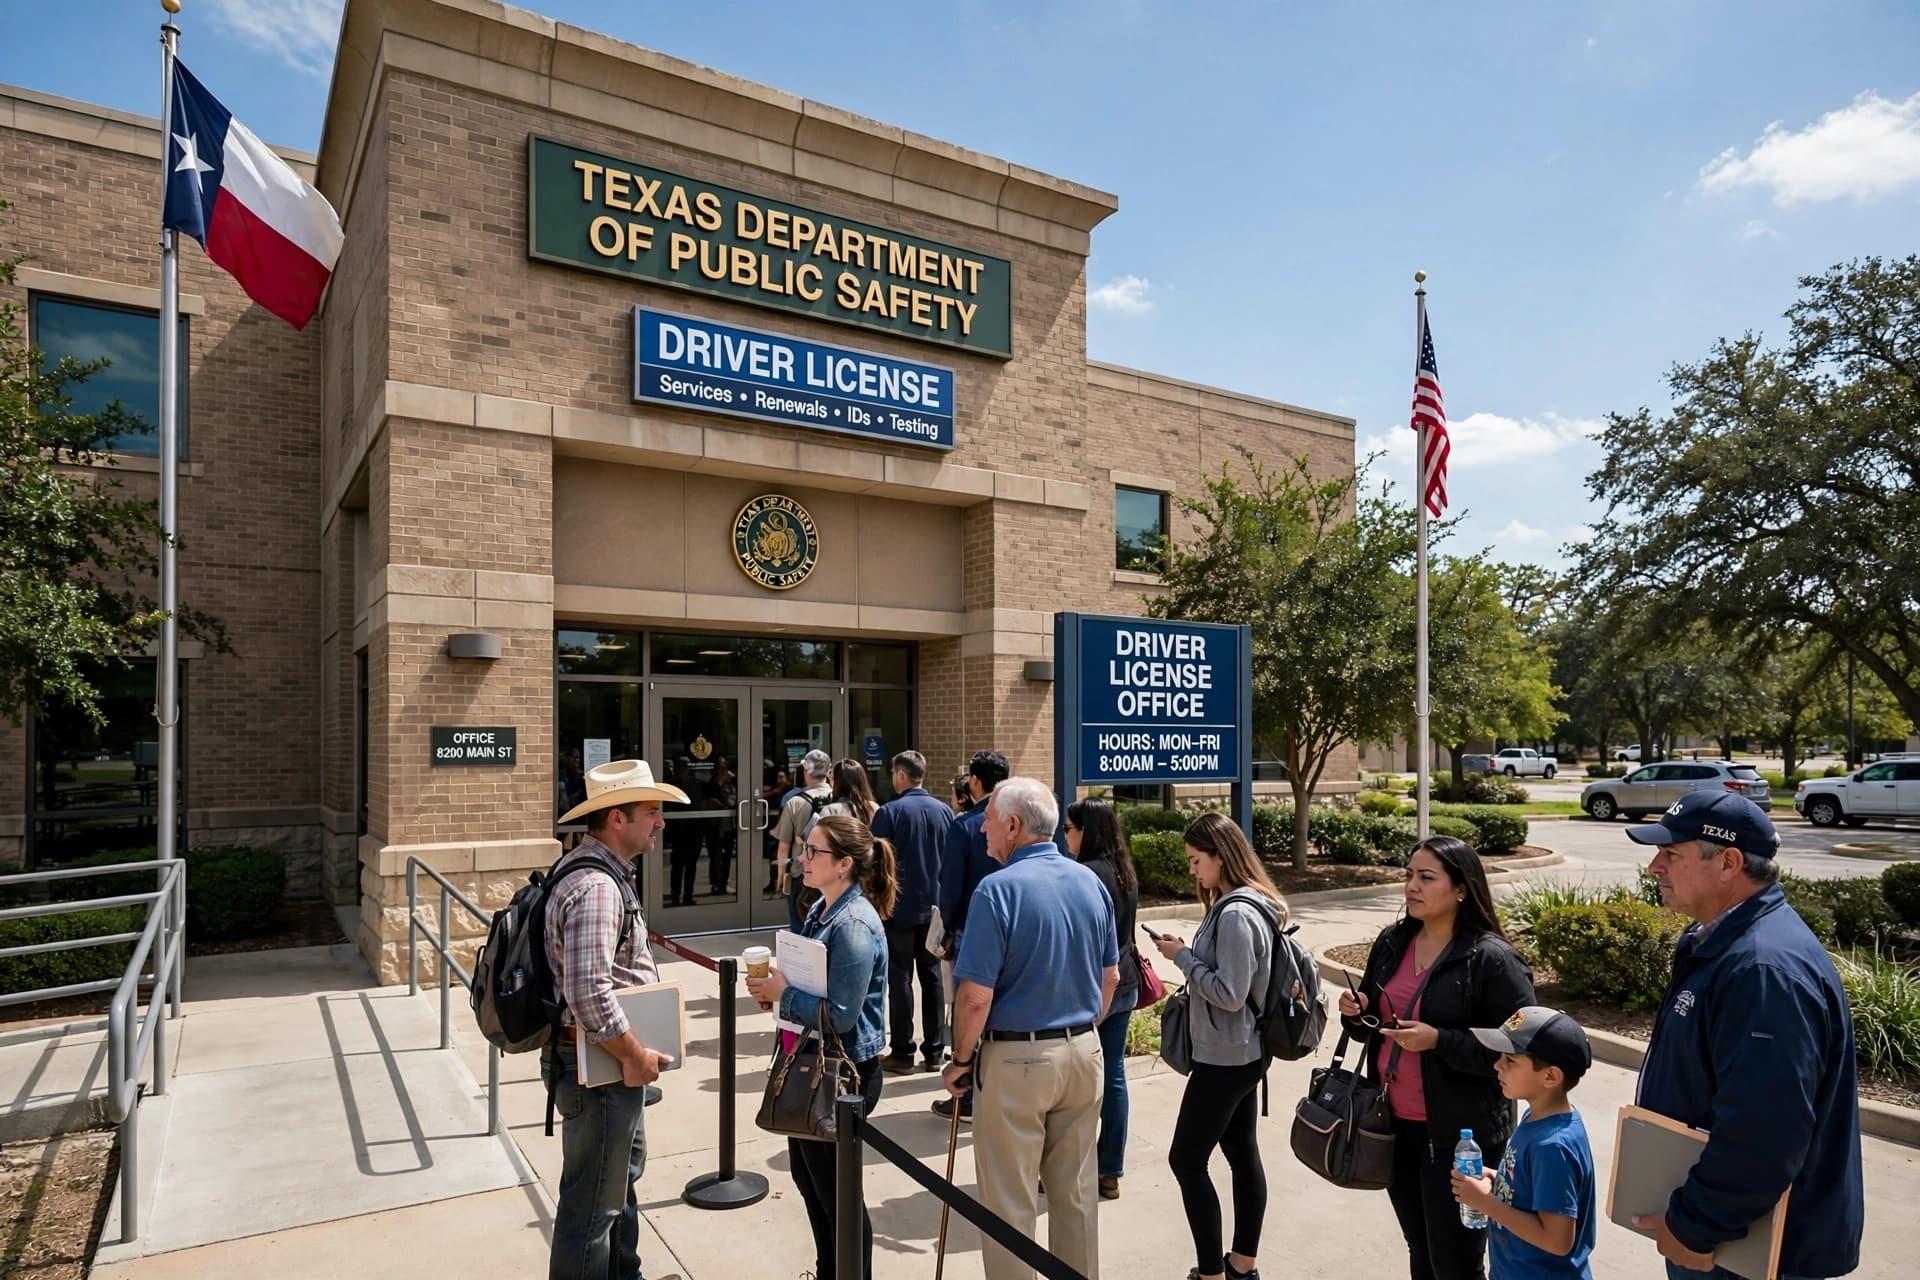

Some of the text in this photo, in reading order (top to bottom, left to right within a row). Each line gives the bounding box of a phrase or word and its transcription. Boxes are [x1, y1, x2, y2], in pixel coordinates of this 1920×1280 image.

[574, 160, 984, 294] TEXAS DEPARTMENT
[590, 216, 977, 335] OF PUBLIC SAFETY
[659, 323, 940, 408] DRIVER LICENSE
[660, 374, 939, 440] Services Renewals IDs Testing
[1116, 630, 1206, 660] DRIVER
[1110, 660, 1212, 689] LICENSE
[1117, 691, 1205, 718] OFFICE
[453, 732, 495, 744] OFFICE
[1099, 733, 1155, 751] HOURS:
[436, 746, 512, 759] 8200 MAIN ST
[1099, 754, 1154, 772] 8:00AM
[1170, 754, 1219, 771] 5:00PM
[1702, 824, 1737, 842] TEXAS
